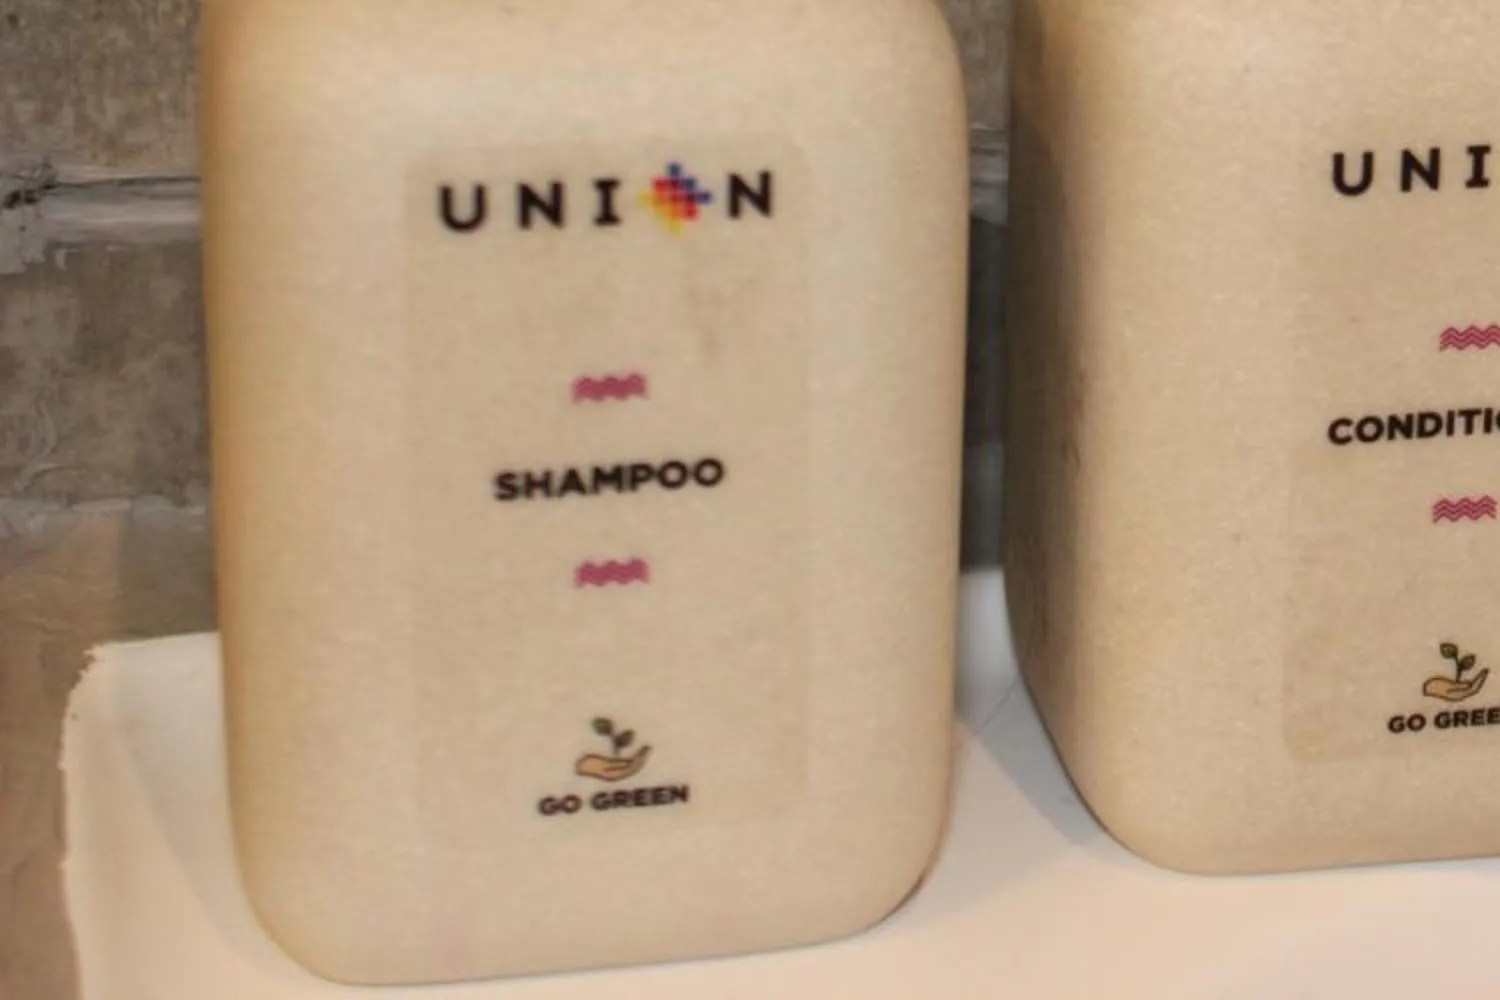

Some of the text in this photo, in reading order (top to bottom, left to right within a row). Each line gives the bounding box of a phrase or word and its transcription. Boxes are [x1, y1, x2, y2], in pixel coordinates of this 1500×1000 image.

[492, 456, 726, 502] SHAMPOO
[1386, 711, 1428, 735] GO
[537, 784, 690, 817] GO GREEN
